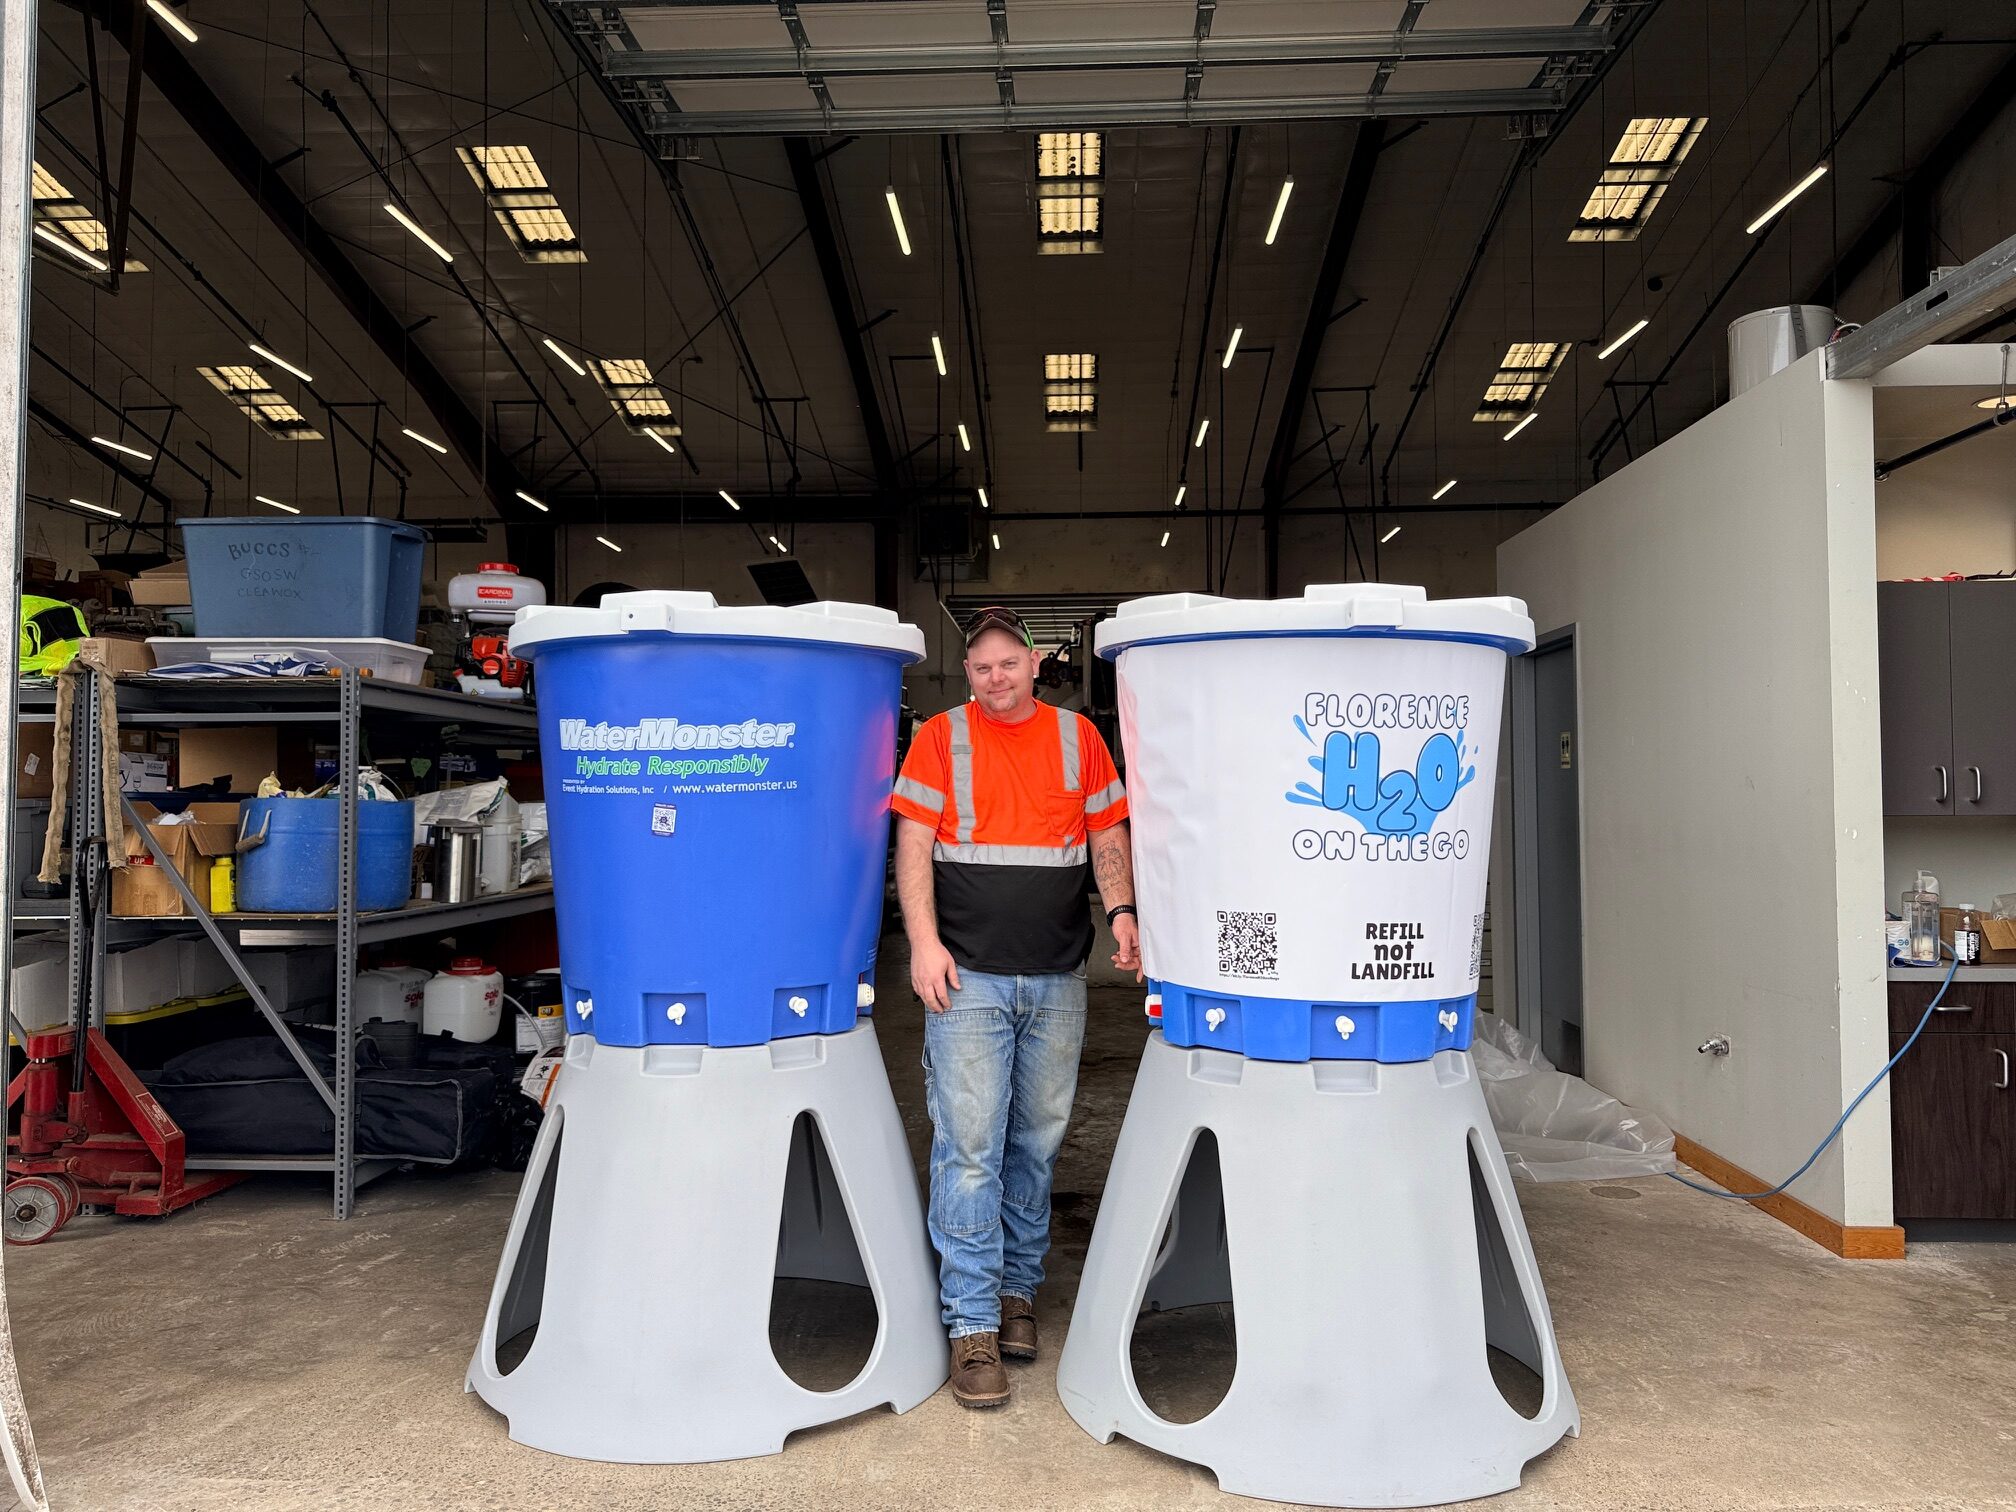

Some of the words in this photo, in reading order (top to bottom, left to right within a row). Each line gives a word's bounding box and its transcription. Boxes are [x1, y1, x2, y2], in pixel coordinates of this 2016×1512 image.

[228, 542, 290, 561] BUCCS
[1305, 692, 1470, 729] FLORENCE
[559, 718, 796, 751] WaterMonster
[576, 756, 641, 779] Hydrate
[647, 754, 769, 779] Responsibly
[562, 784, 576, 793] Event
[576, 785, 604, 794] Hydration
[606, 785, 640, 795] Solutions,
[672, 780, 798, 793] www.watermonster.us
[1321, 730, 1460, 832] H2O
[1292, 829, 1355, 861] ON
[1360, 832, 1429, 861] THE
[1432, 829, 1470, 860] GO
[1365, 923, 1424, 940] REFILL
[1373, 941, 1415, 960] not
[1968, 932, 1976, 960] vitamin
[1351, 962, 1434, 980] LANDFILL
